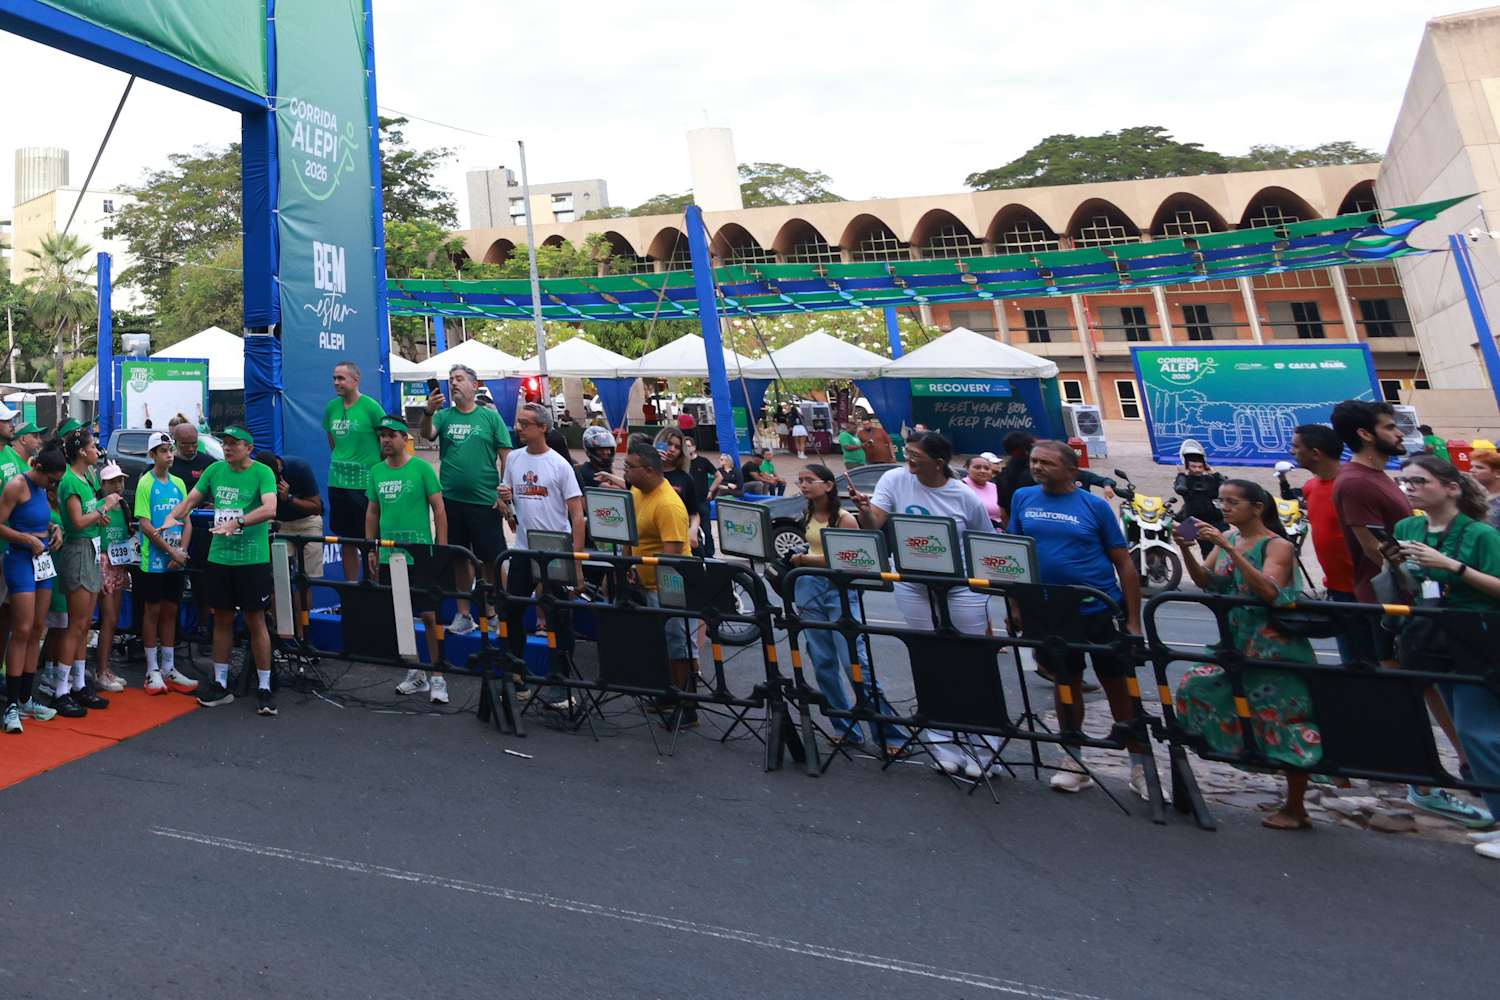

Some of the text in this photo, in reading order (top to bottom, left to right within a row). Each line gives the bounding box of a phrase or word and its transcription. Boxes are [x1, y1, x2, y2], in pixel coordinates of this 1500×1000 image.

[290, 97, 337, 132] CORRIDA
[291, 121, 337, 162] ALEPI
[305, 160, 328, 182] 2026
[313, 241, 346, 293] BEM
[304, 285, 357, 330] estar
[319, 332, 345, 350] ALEPI
[1160, 363, 1199, 373] ALEPI
[130, 373, 148, 381] ALEPI
[929, 383, 991, 392] RECOVERY
[934, 401, 972, 413] RESET
[949, 415, 980, 428] KEEP
[378, 480, 402, 488] CORRIDA
[379, 486, 402, 494] ALEPI
[216, 491, 239, 500] ALEPI
[1025, 511, 1080, 523] EQUATORIAL
[110, 548, 128, 558] 6239
